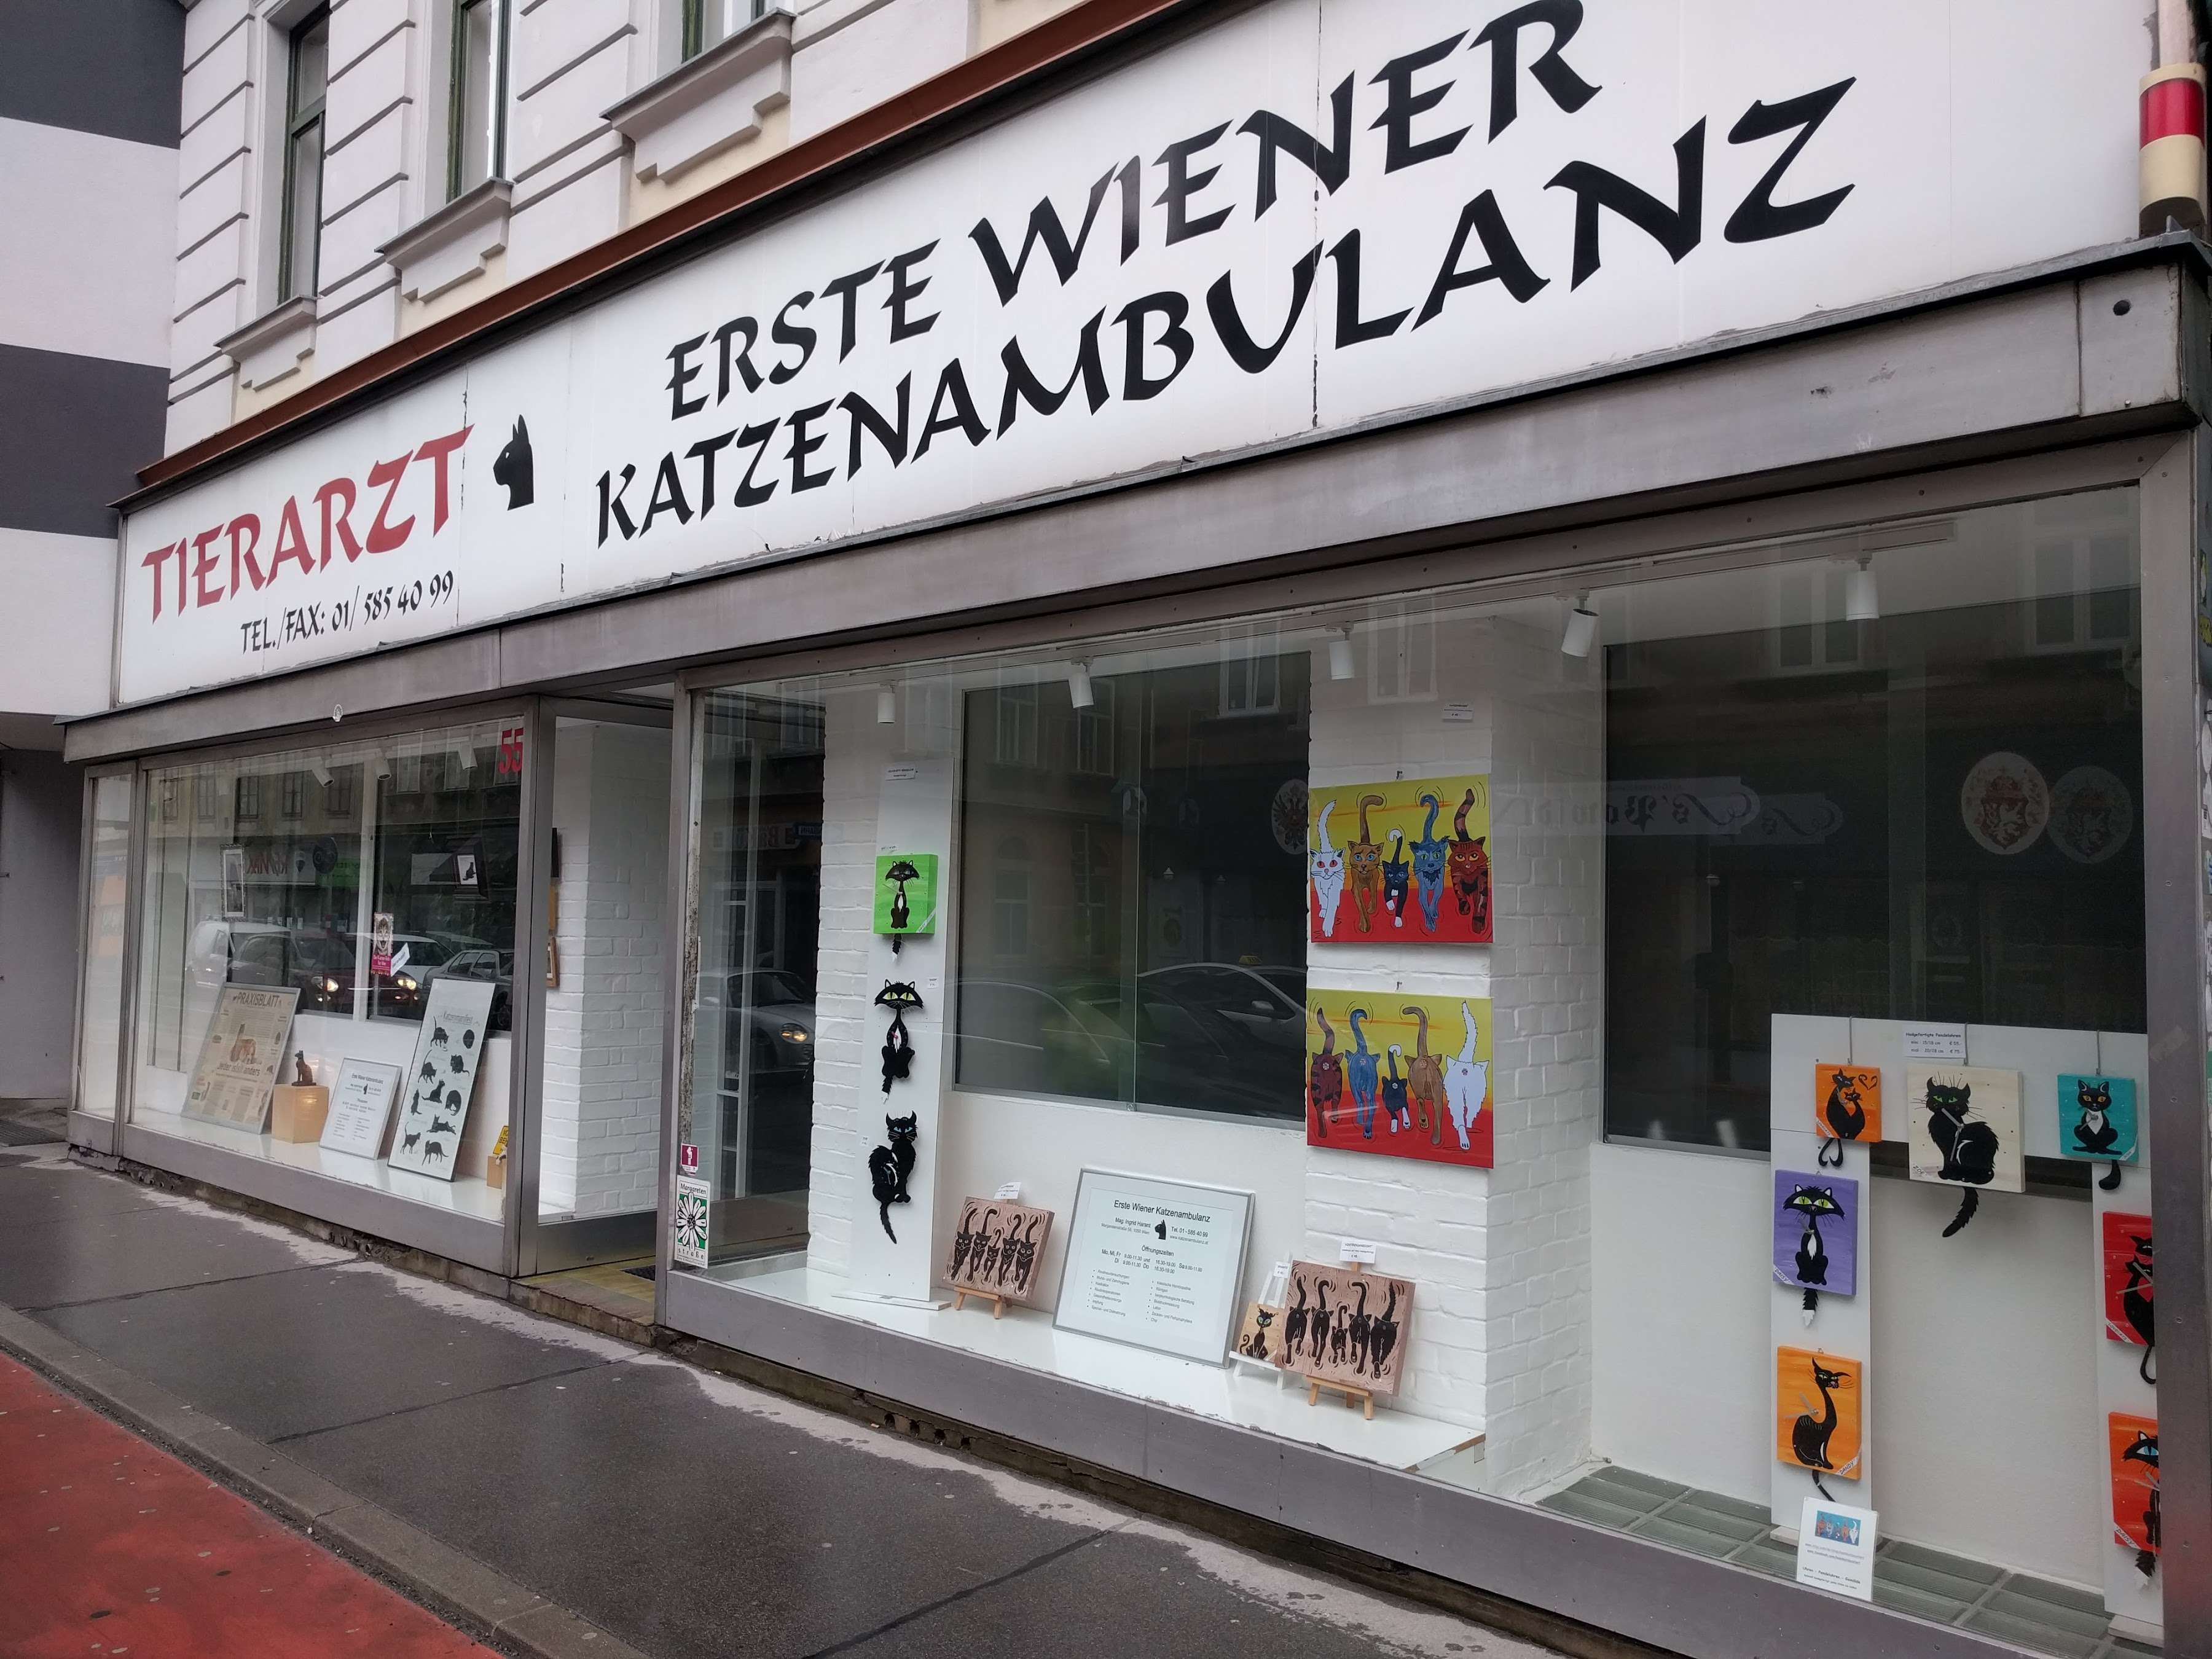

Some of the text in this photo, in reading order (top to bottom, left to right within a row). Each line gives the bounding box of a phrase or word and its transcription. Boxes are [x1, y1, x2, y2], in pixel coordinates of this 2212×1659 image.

[665, 0, 1601, 420] ERSTE WIENER
[595, 76, 1858, 547] KATZENAMBULANZ
[141, 423, 475, 624] TIERARZT
[332, 584, 360, 632] 01/
[364, 588, 391, 626] 585
[393, 579, 423, 616] 40
[429, 570, 454, 605] 99
[498, 728, 524, 774] 55
[237, 992, 280, 1008] PRAXISBLATT
[680, 1183, 707, 1194] Margareten
[1114, 1200, 1210, 1223] Erste Wiener Katzenambulanz
[678, 1248, 704, 1260] straße
[1141, 1245, 1174, 1257] Öffnungszeiten
[1839, 1461, 1853, 1475] DANDY
